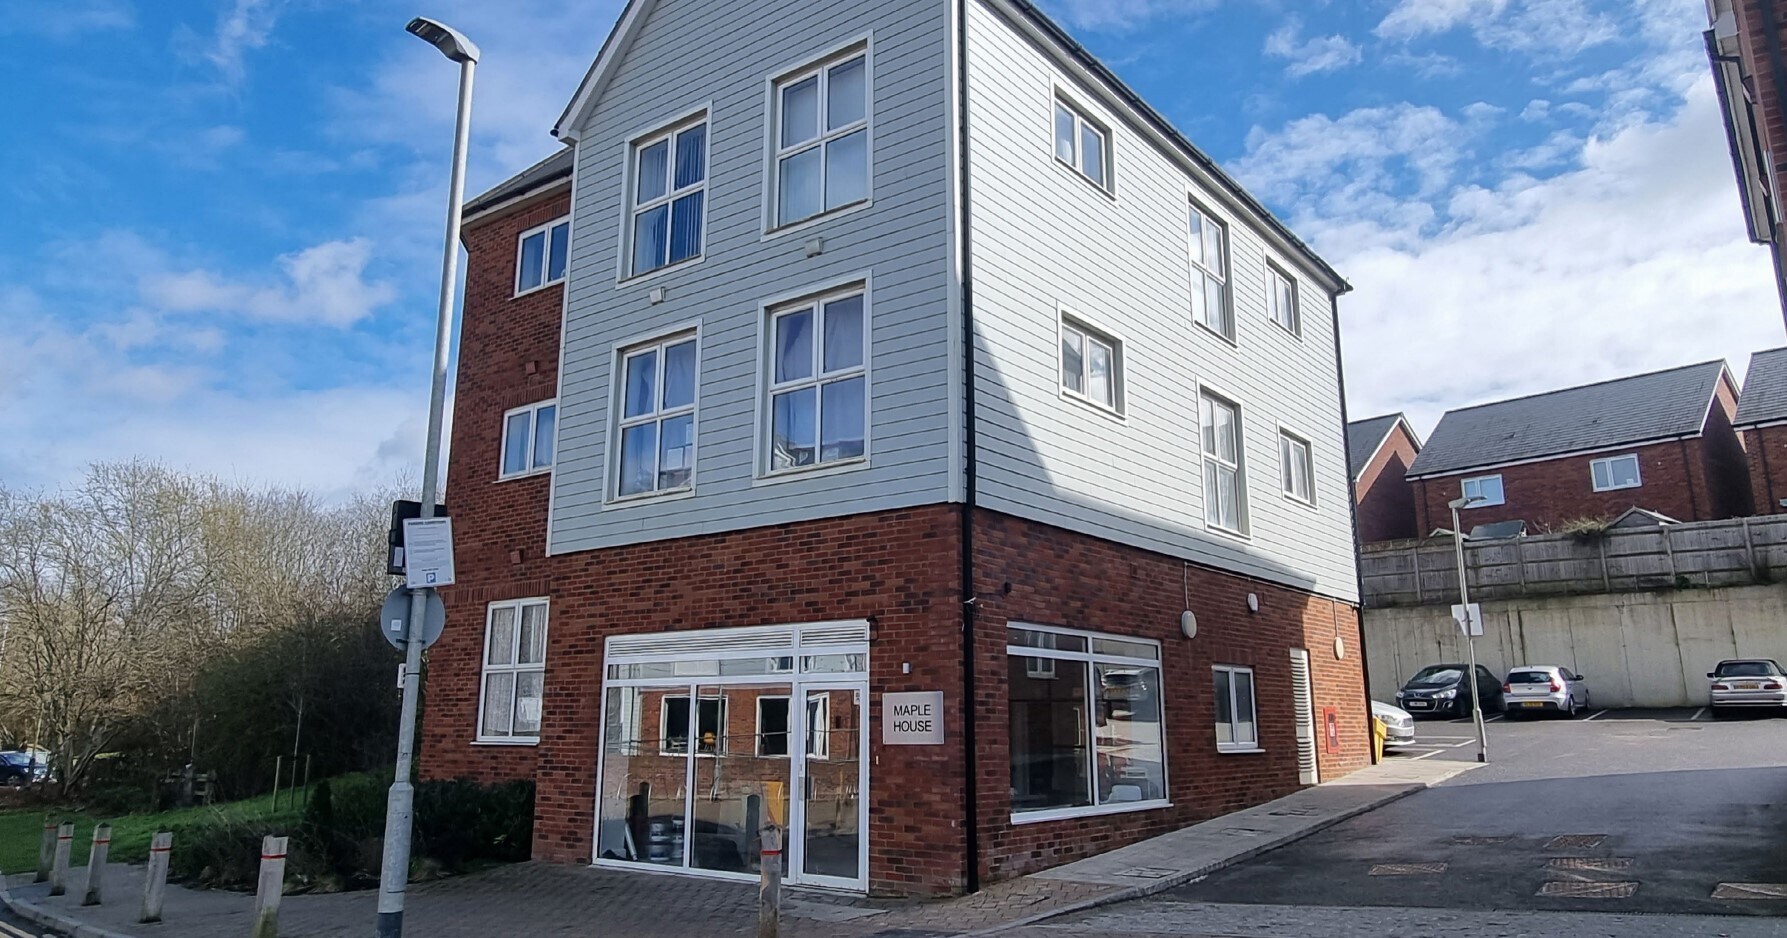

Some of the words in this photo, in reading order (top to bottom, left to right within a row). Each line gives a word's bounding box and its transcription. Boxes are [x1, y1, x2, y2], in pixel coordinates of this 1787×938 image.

[427, 573, 435, 583] P
[893, 704, 931, 716] MAPLE
[893, 720, 932, 732] HOUSE
